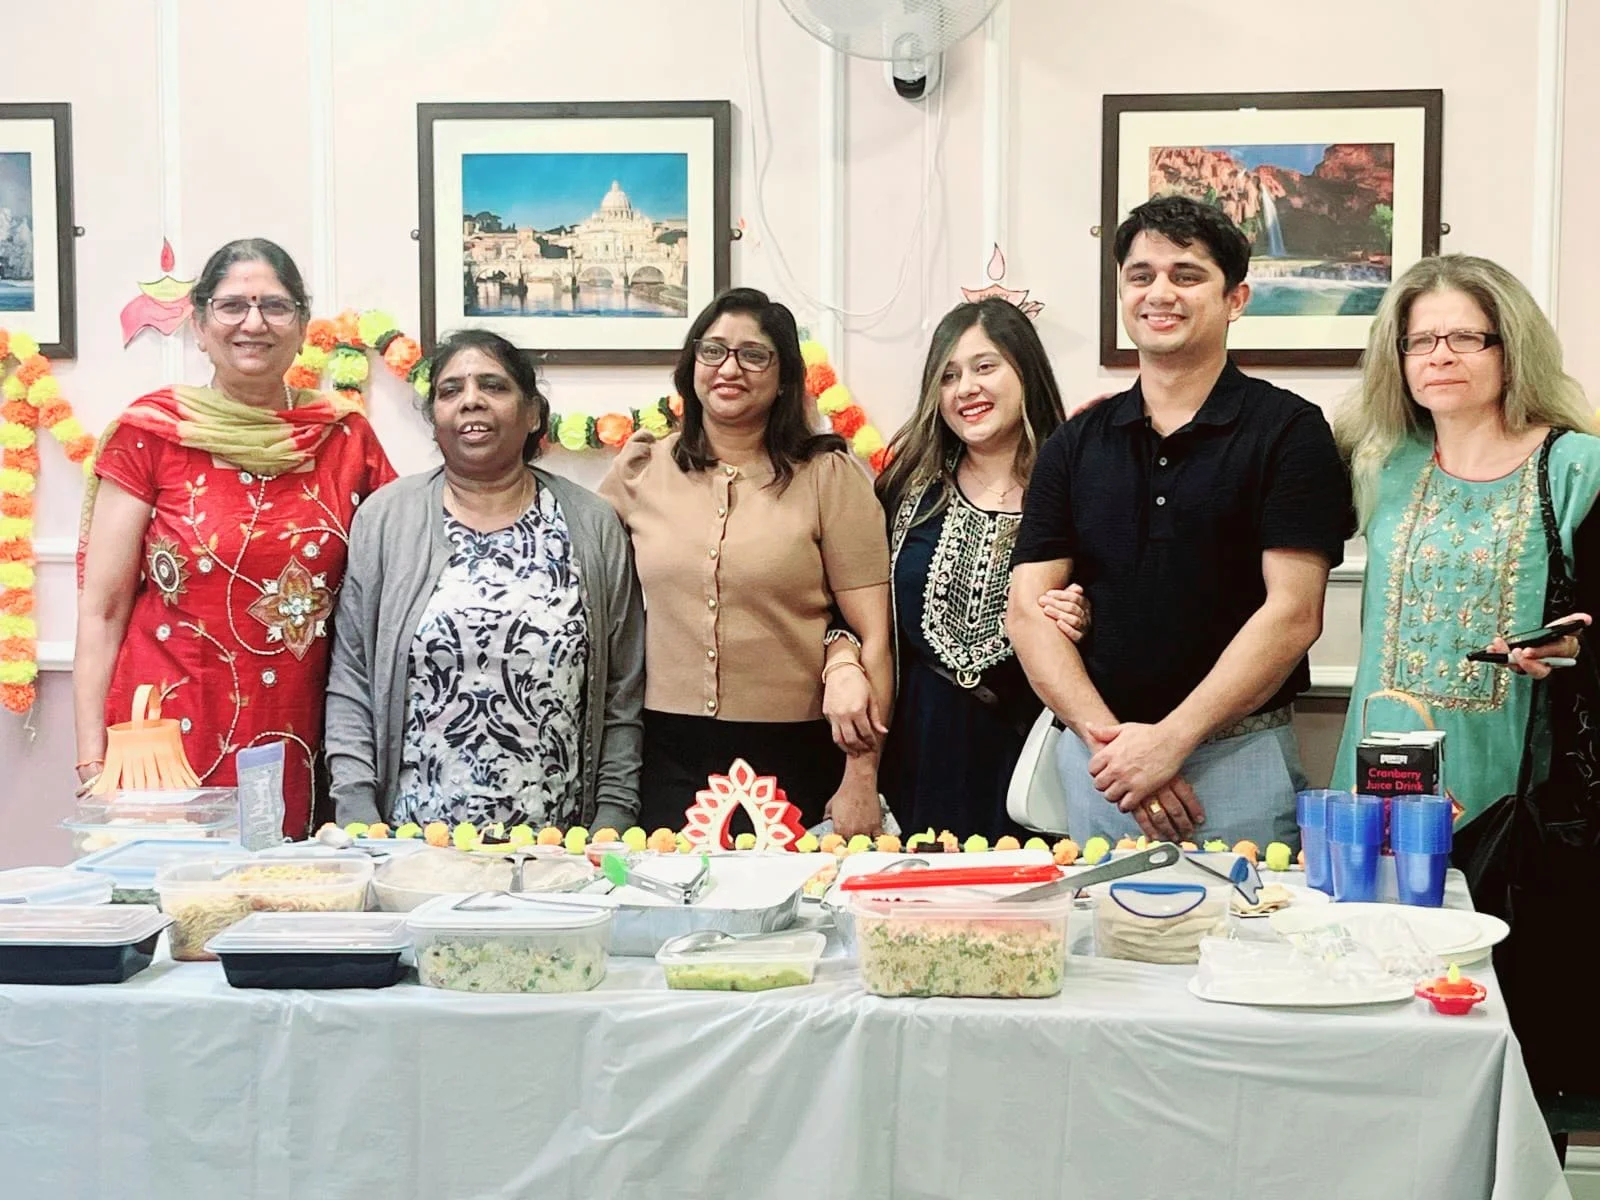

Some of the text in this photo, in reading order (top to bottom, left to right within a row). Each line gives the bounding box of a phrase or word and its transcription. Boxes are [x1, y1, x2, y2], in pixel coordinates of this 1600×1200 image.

[1368, 767, 1422, 780] Cranberry
[1366, 780, 1424, 792] Juice Drink
